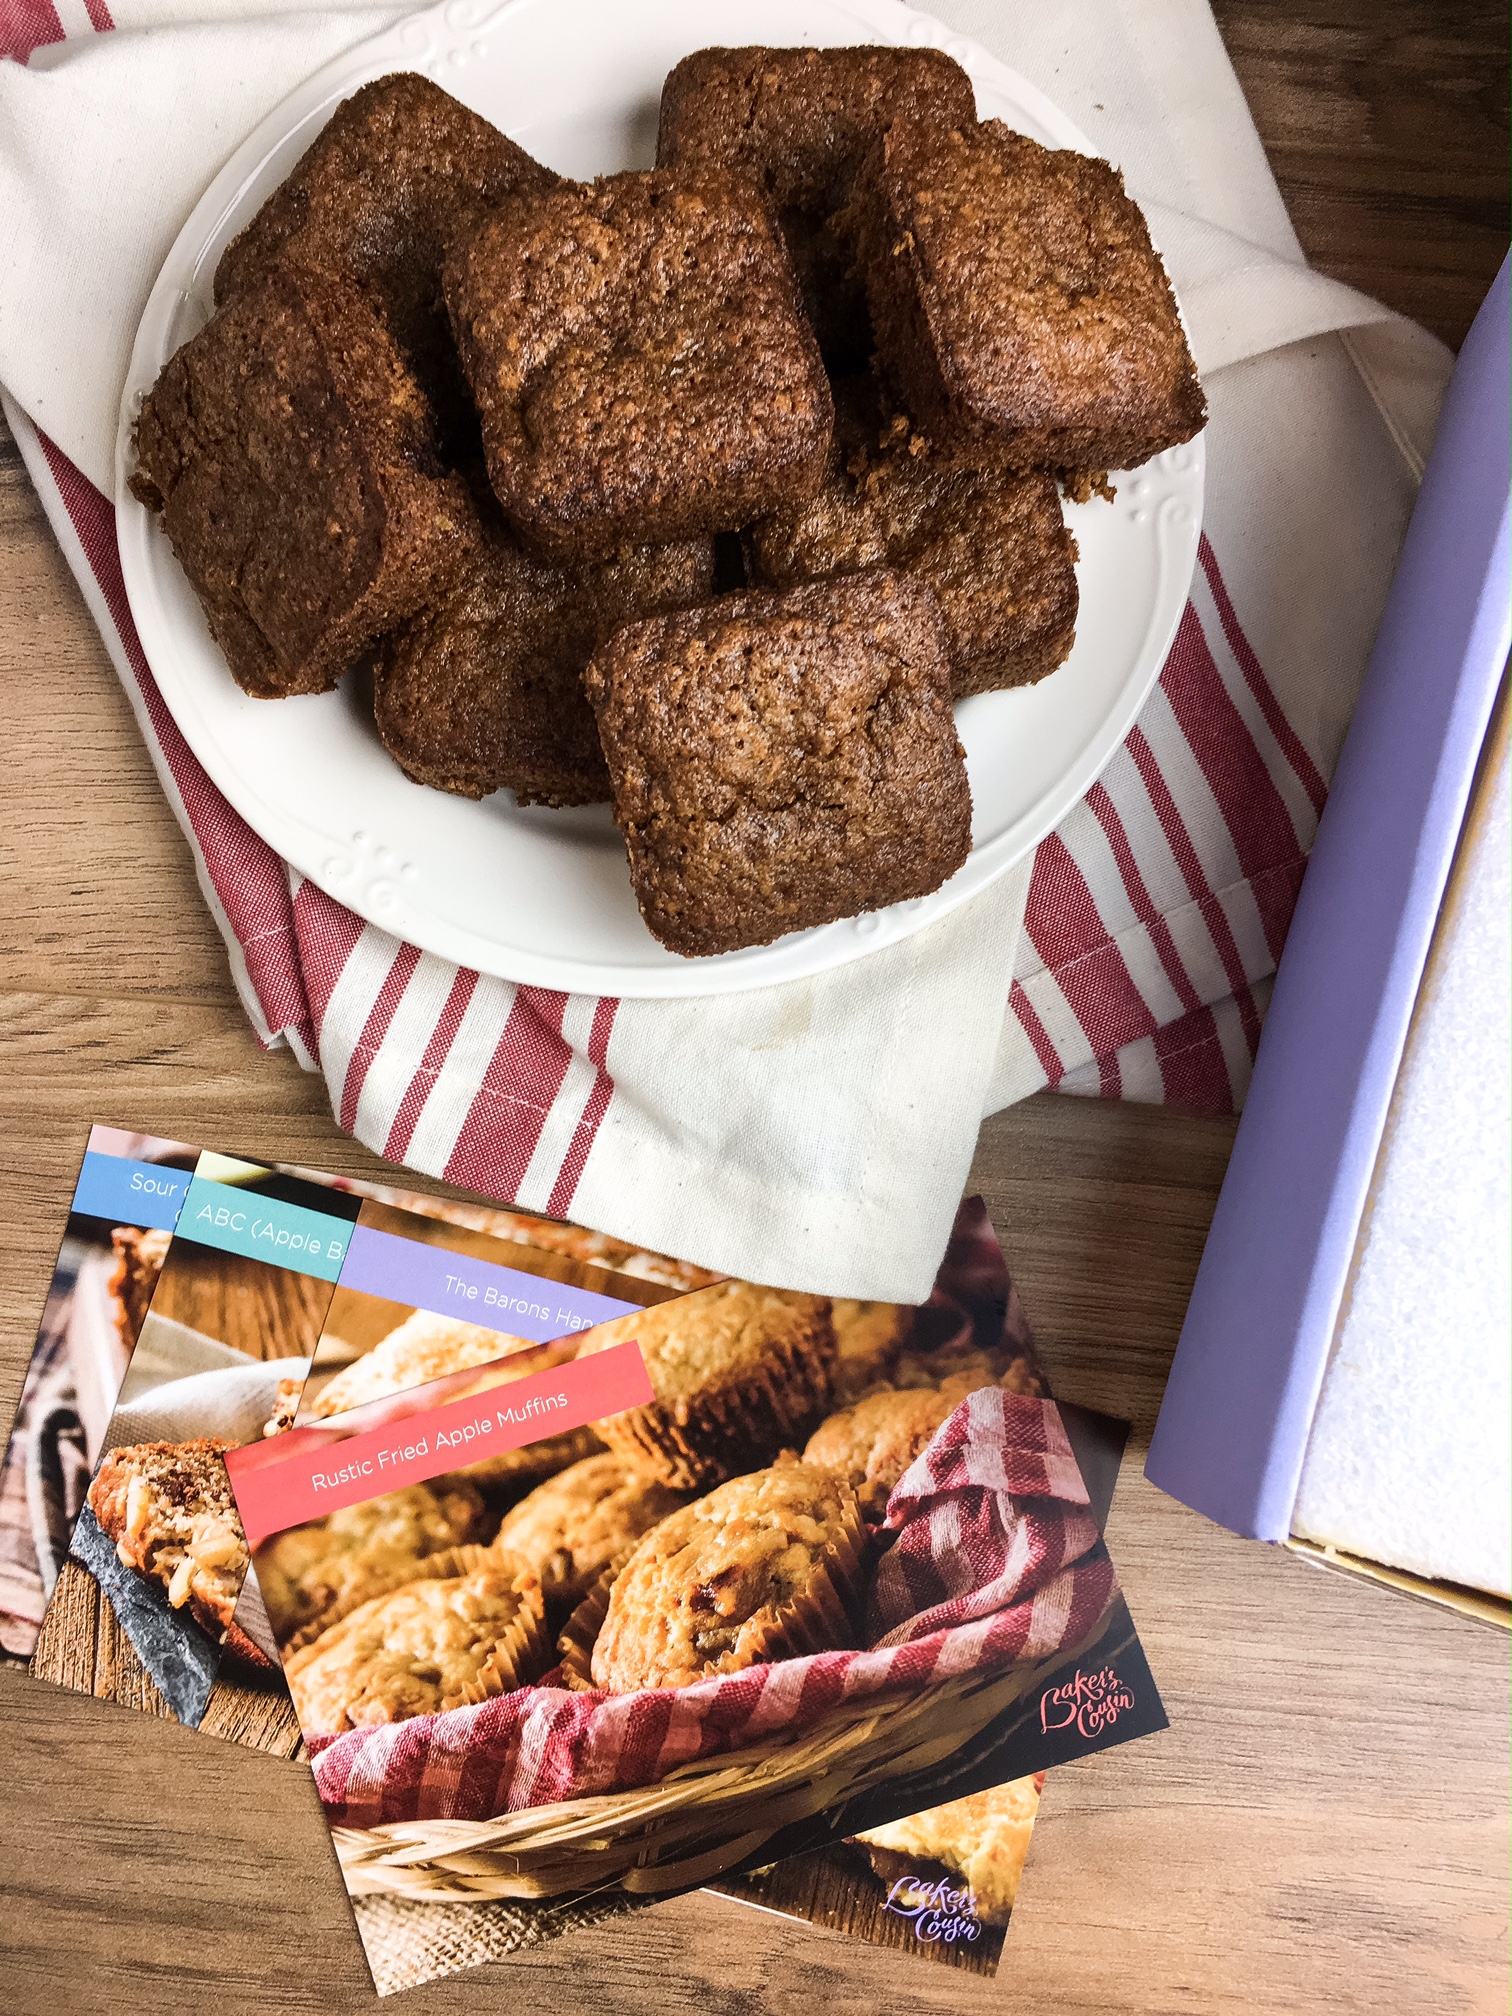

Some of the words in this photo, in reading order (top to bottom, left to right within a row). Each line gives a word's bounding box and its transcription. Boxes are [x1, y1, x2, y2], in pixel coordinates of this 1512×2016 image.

[130, 1172, 178, 1198] Sour
[196, 1203, 247, 1232] ABC
[250, 1218, 322, 1255] (Apple
[445, 1274, 478, 1300] The
[483, 1286, 550, 1321] Barons
[311, 1458, 374, 1492] Rustic
[377, 1437, 429, 1469] Fried
[434, 1418, 493, 1450] Apple
[496, 1392, 569, 1428] Muffins
[1039, 1665, 1123, 1735] Baker's
[1076, 1686, 1135, 1738] Cousin
[914, 1909, 982, 1942] Cousin
